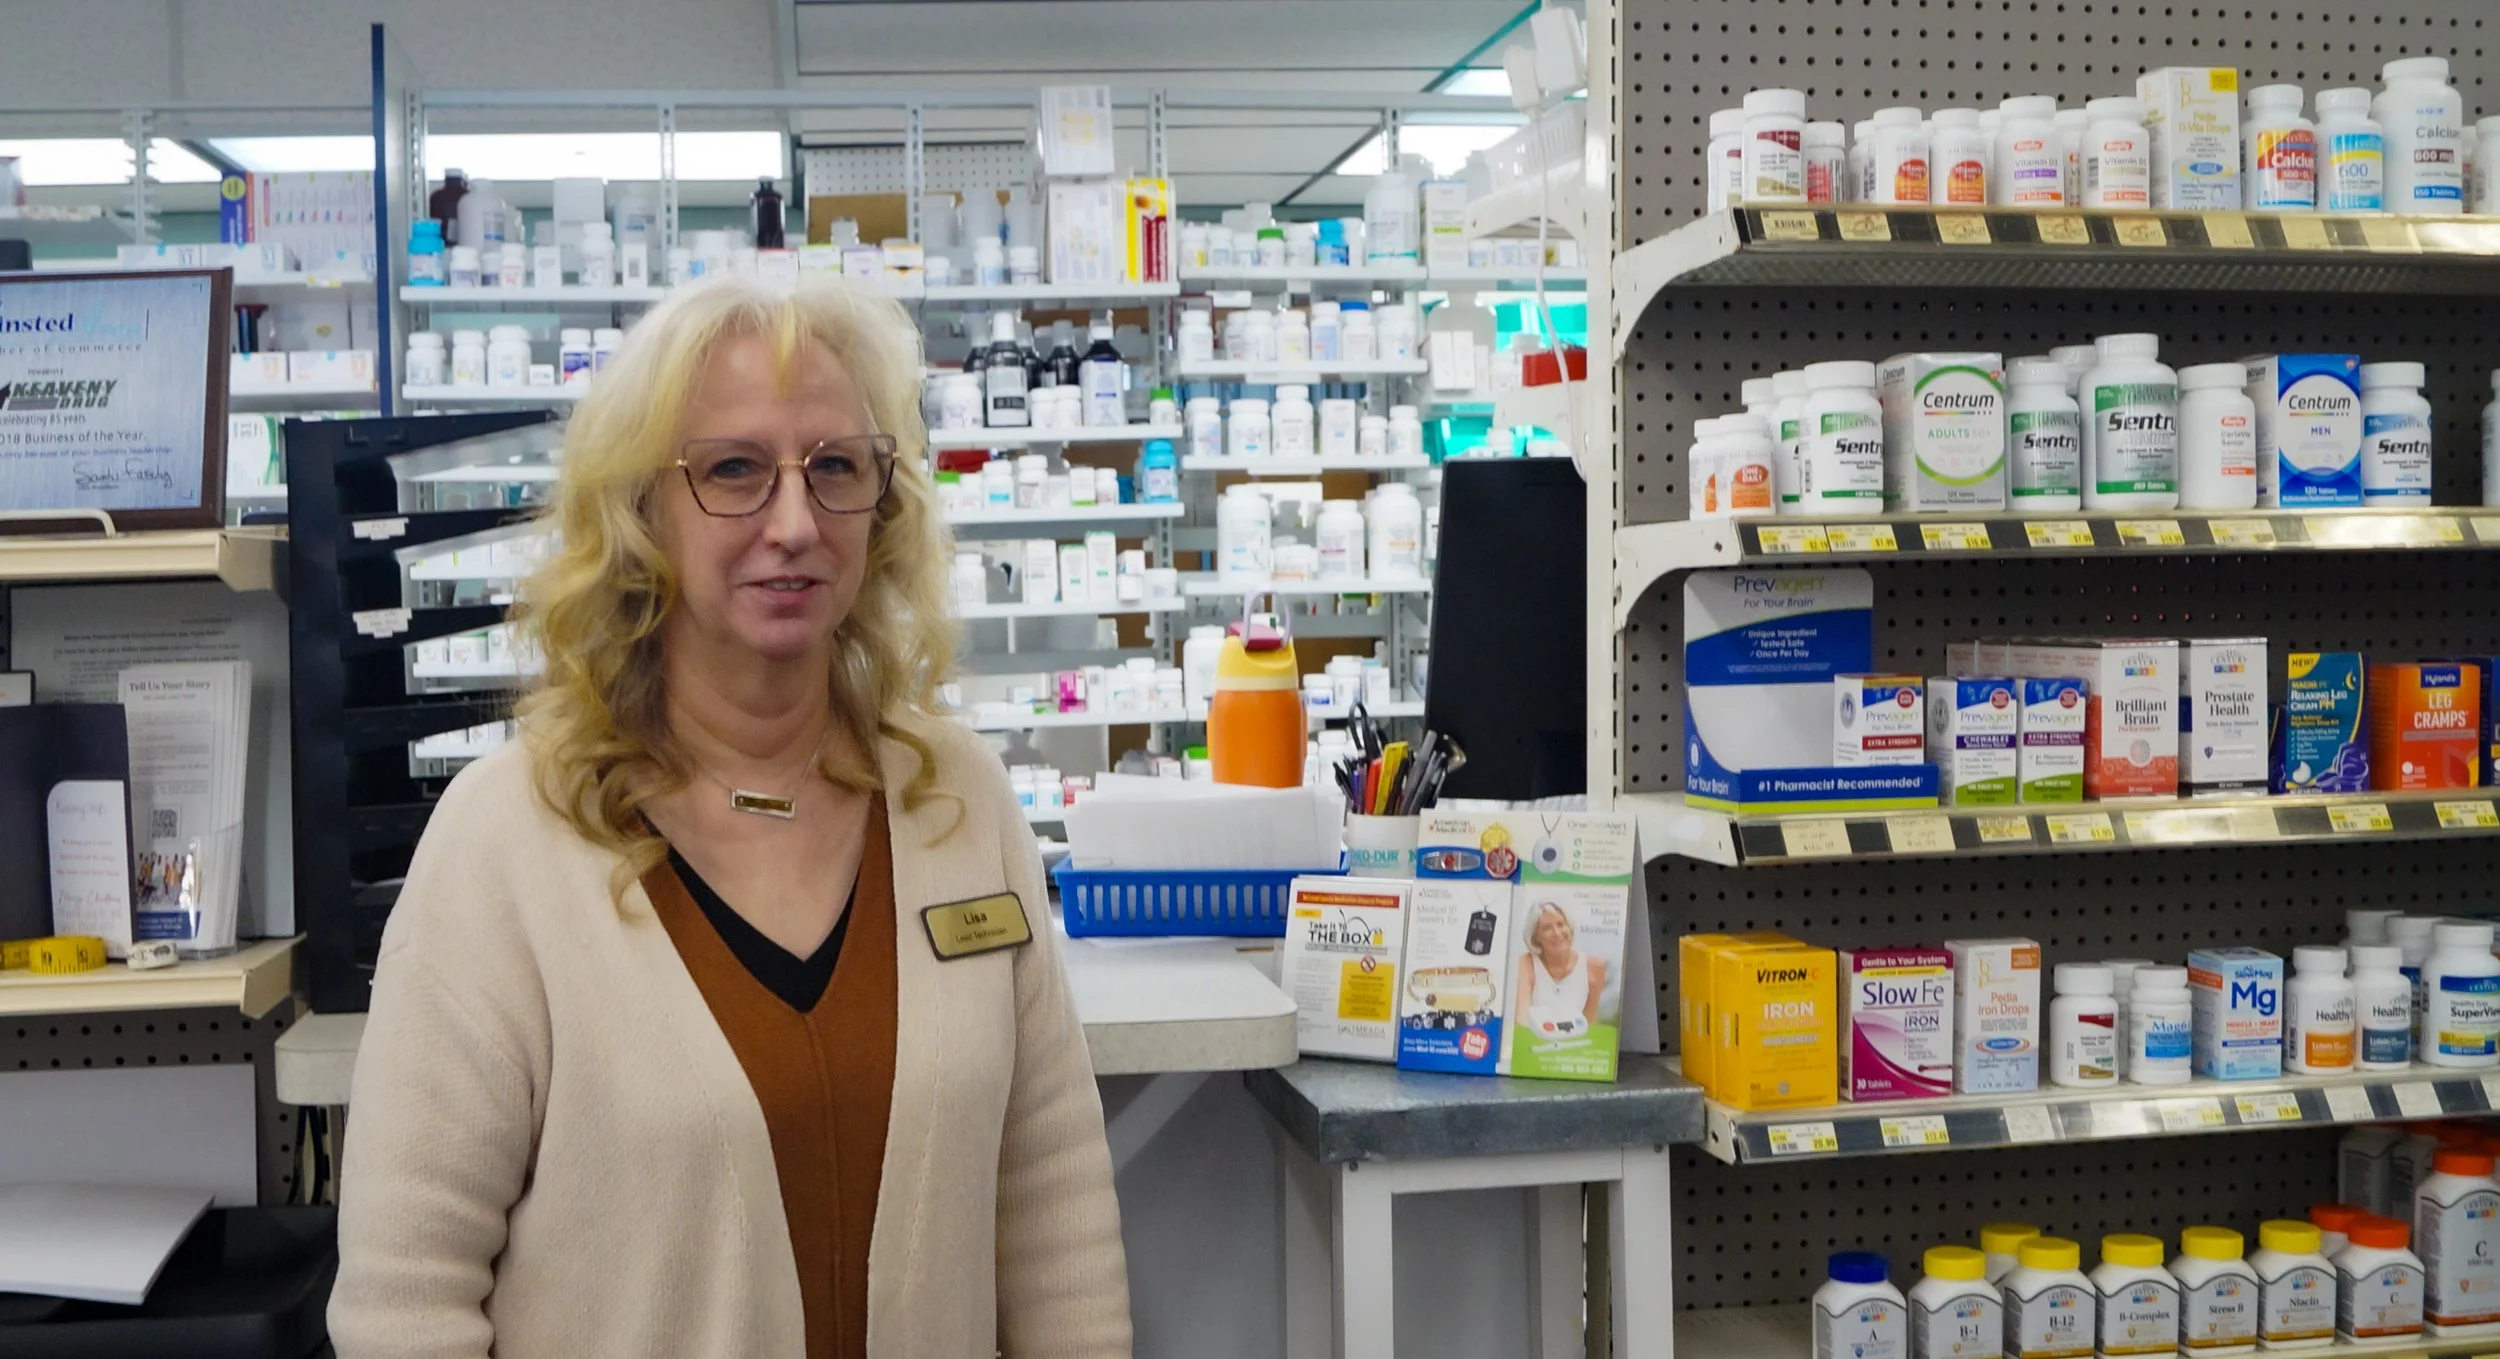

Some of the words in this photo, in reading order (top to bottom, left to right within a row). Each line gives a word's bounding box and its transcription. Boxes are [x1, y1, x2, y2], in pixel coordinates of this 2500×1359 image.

[2105, 157, 2136, 165] Vitamin
[2414, 150, 2438, 161] 600
[2439, 151, 2454, 163] mg
[2338, 163, 2368, 178] 600
[58, 342, 142, 353] Commerce
[13, 379, 118, 397] KEAVENY
[59, 396, 110, 409] DRUG
[1923, 391, 1995, 409] Centrum
[2288, 394, 2351, 410] Centrum
[24, 429, 75, 444] Business
[78, 430, 91, 442] of
[99, 429, 114, 442] the
[1927, 428, 1970, 440] ADULTS
[2310, 426, 2331, 436] MEN
[1742, 473, 1762, 483] DAILY
[1733, 575, 1824, 596] Prevagen
[1744, 598, 1760, 608] For
[1763, 598, 1784, 608] Your
[1786, 597, 1813, 608] Brain
[1748, 629, 1775, 640] Unique
[1777, 628, 1817, 639] Ingredient
[1760, 639, 1785, 648] Tested
[1787, 639, 1805, 648] Safe
[1756, 649, 1777, 658] Once
[1779, 649, 1793, 658] Per
[1794, 649, 1809, 660] Day
[2292, 658, 2314, 667] NEW!
[129, 682, 146, 692] Tell
[161, 681, 183, 691] Your
[185, 680, 210, 692] Story
[2425, 674, 2457, 685] Hyland's
[2205, 690, 2255, 703] Prostate
[2428, 692, 2453, 709] LEG
[2115, 699, 2167, 712] Brilliant
[2209, 703, 2250, 717] Health
[2319, 699, 2335, 711] PM
[1865, 710, 1918, 725] Prevagen
[1960, 711, 2014, 724] Prevagen
[2028, 712, 2081, 725] Prevagen
[2124, 711, 2159, 725] Brain
[2413, 711, 2467, 729] CRAMPS
[1867, 738, 1886, 747] EXTRA
[1887, 738, 1917, 747] STRENGTH
[1964, 735, 2009, 743] CHEWABLES
[1688, 776, 1698, 789] For
[1699, 777, 1712, 792] Your
[1711, 779, 1729, 795] Brain
[1758, 781, 1771, 792] #1
[1775, 779, 1834, 792] Pharmacist
[1837, 777, 1921, 790] Recommended
[1433, 819, 1471, 827] American
[1435, 825, 1467, 834] Medical
[963, 911, 988, 926] Lisa
[1309, 921, 1328, 929] Take
[1308, 930, 1338, 943] THE
[1341, 932, 1372, 945] BOX
[1861, 957, 1887, 967] Gentle
[1888, 957, 1897, 966] to
[1898, 957, 1916, 966] Your
[1917, 955, 1947, 966] System
[1862, 980, 1918, 1006] Slow
[1922, 978, 1945, 1003] Fe
[1990, 992, 2018, 1003] Pedia
[2231, 981, 2277, 1016] Mg
[1763, 999, 1815, 1020] IRON
[1978, 1005, 1998, 1016] Iron
[2000, 1004, 2030, 1017] Drops
[2315, 1009, 2350, 1022] Healthy
[2373, 1004, 2407, 1018] Healthy
[1904, 1015, 1940, 1028] IRON
[1867, 1079, 1892, 1089] Tablets
[2475, 1240, 2488, 1259] C
[2289, 1296, 2320, 1307] Niacin
[2389, 1293, 2399, 1305] C
[2209, 1305, 2234, 1315] Stress
[2235, 1304, 2245, 1314] B
[2049, 1316, 2075, 1328] B-12
[2118, 1311, 2171, 1323] B-Complex
[1868, 1330, 1879, 1342] A
[1959, 1325, 1979, 1338] B-1
